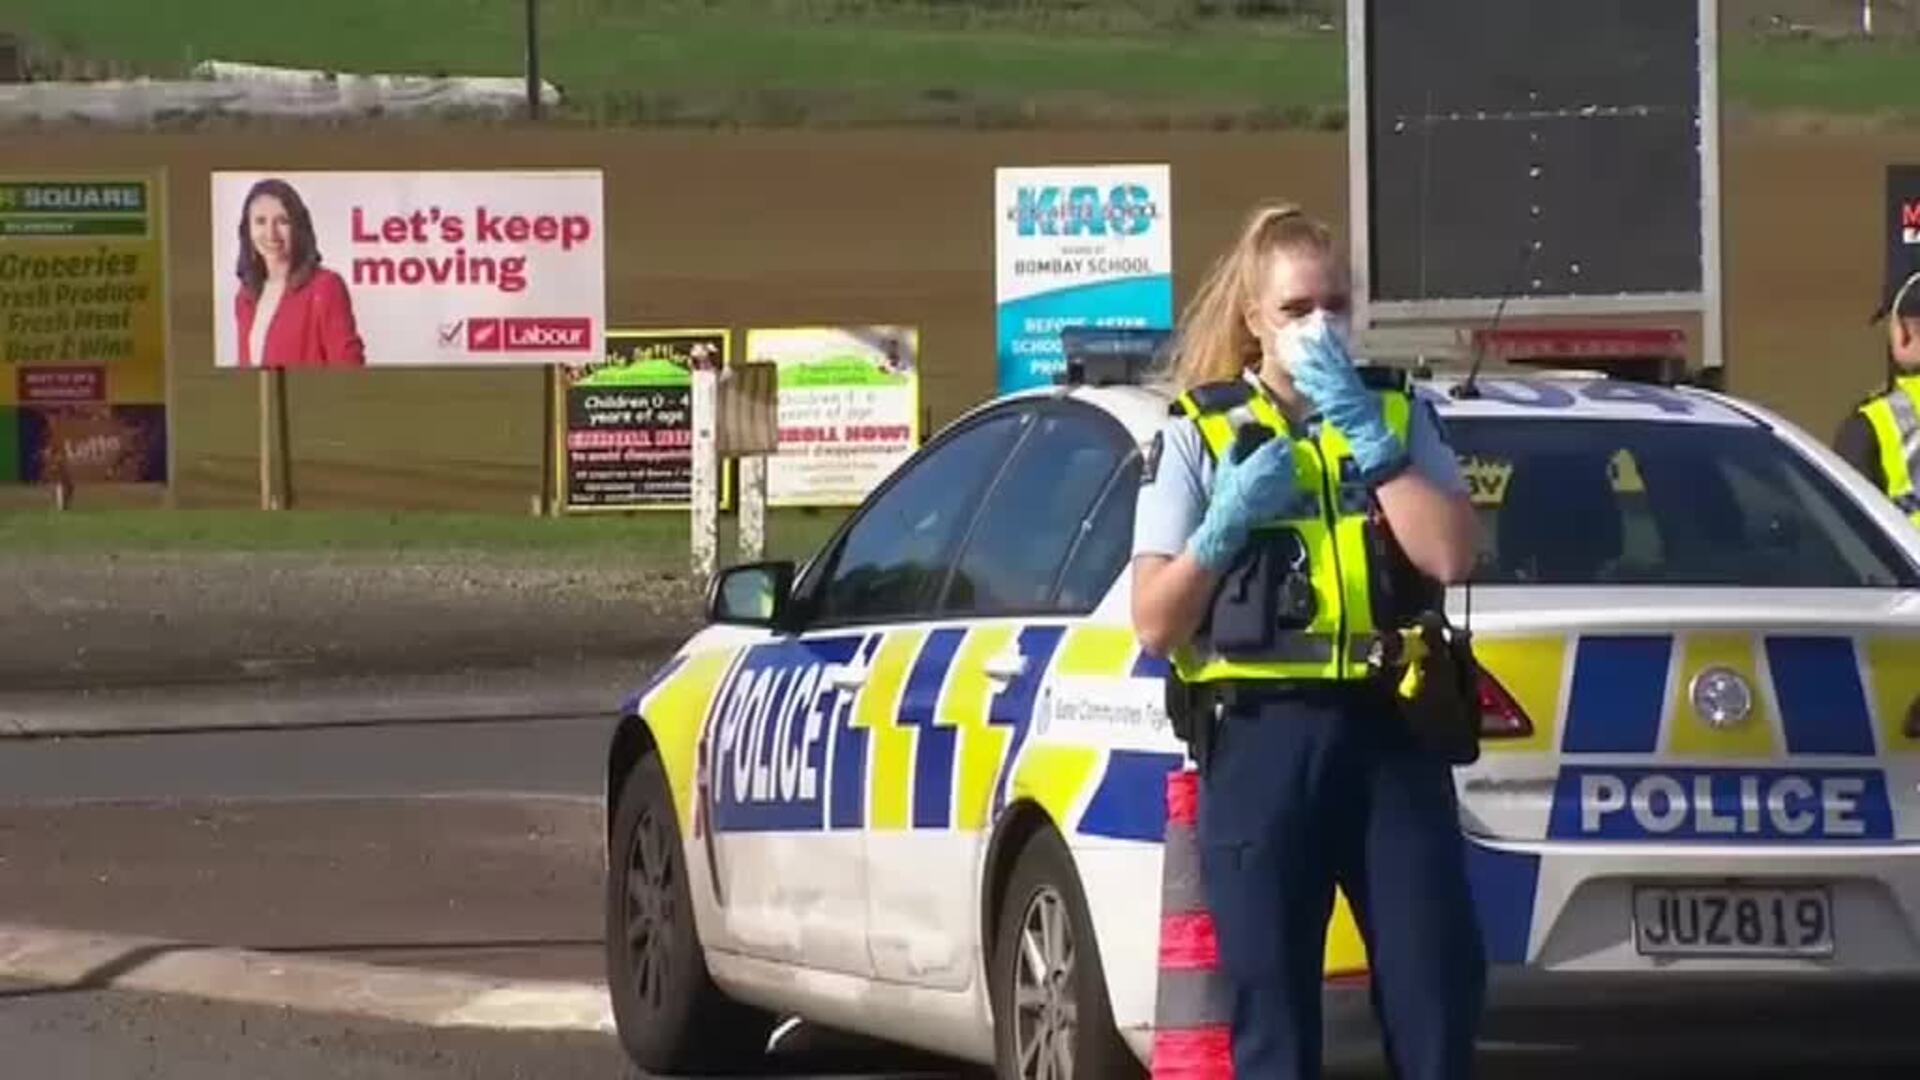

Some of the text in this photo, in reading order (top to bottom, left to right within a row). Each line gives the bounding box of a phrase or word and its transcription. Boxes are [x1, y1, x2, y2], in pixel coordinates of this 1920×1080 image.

[23, 187, 140, 208] SQUARE
[476, 208, 591, 250] keep
[0, 246, 137, 279] Groceries
[351, 250, 528, 292] moving
[1014, 257, 1152, 274] BOMBAY SCHOOL
[509, 323, 585, 346] Labour
[584, 394, 649, 409] Children
[590, 407, 685, 426] years of age
[714, 662, 840, 803] POLICE
[1580, 773, 1866, 834] POLICE
[1643, 893, 1827, 946] JUZ819
